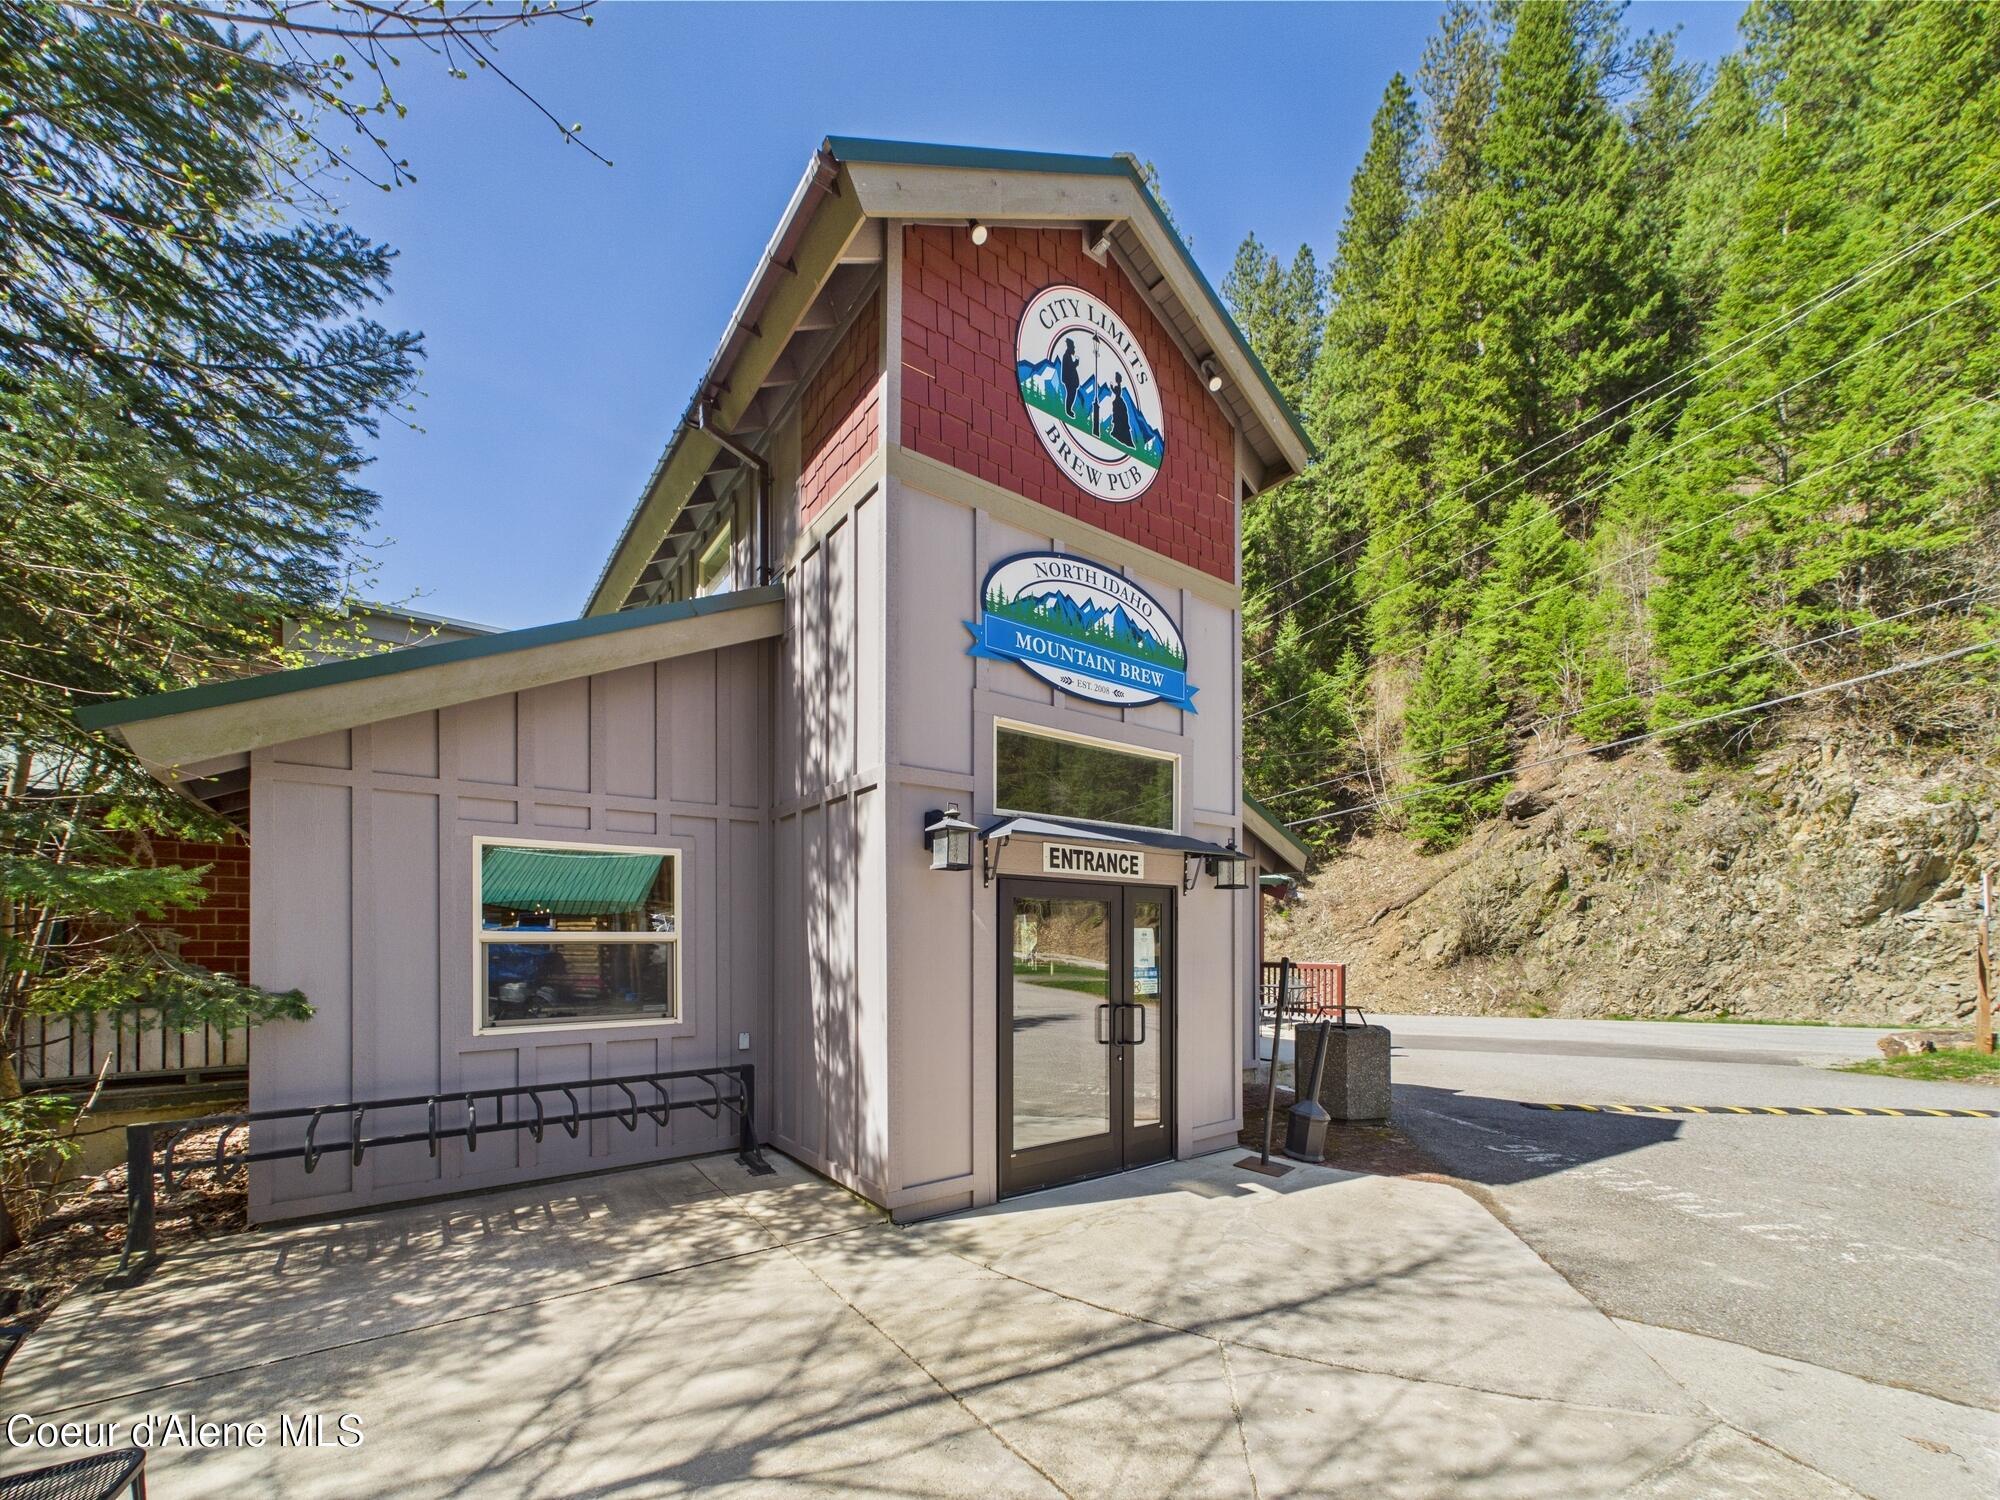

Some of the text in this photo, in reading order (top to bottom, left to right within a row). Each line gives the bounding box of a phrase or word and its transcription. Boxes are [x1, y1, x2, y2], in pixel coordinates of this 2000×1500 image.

[1039, 298, 1149, 385] CITY LIMITS
[1045, 423, 1142, 491] BREW PUB
[1033, 561, 1153, 617] NORTH IDAHO
[1015, 631, 1165, 688] MOUNTAIN BREW
[1077, 679, 1110, 694] EST. 2008
[1049, 847, 1139, 875] ENTRANCE
